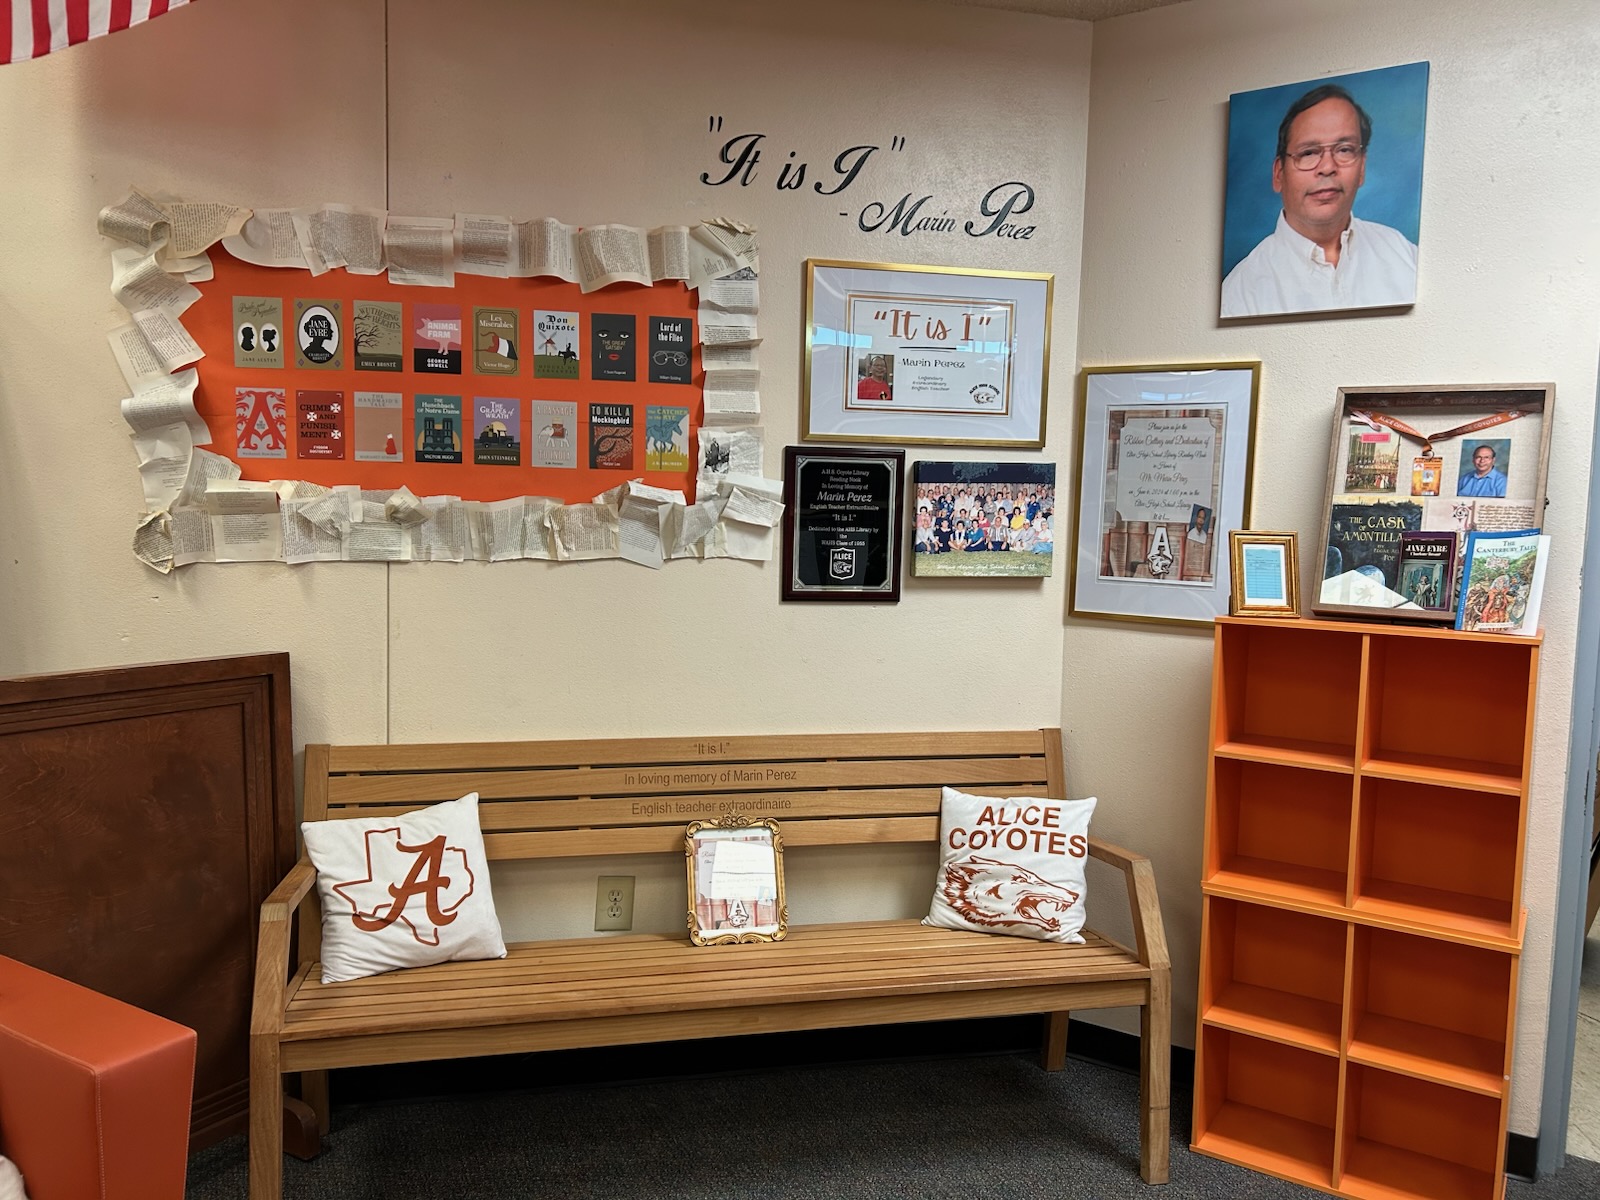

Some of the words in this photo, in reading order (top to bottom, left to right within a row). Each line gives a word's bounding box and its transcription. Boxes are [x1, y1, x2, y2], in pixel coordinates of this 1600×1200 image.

[776, 151, 807, 190] is
[858, 193, 957, 237] Marin
[965, 182, 1036, 240] Perez
[359, 307, 399, 321] WUTHERING
[546, 314, 568, 323] Don
[308, 320, 328, 329] JANE
[372, 315, 401, 329] HEIGHTS
[427, 322, 459, 331] ANIMAL
[538, 322, 575, 332] Quixote
[660, 322, 674, 332] Lord
[675, 323, 682, 332] of
[308, 328, 328, 337] EYRE
[926, 317, 952, 340] is
[427, 330, 451, 338] FARM
[658, 332, 668, 341] the
[669, 333, 683, 342] Flies
[902, 358, 930, 367] Marin
[934, 359, 966, 368] Perez
[480, 406, 506, 414] GRAPES
[508, 408, 514, 416] of
[544, 406, 574, 416] PASSAGE
[592, 406, 600, 414] TO
[604, 406, 622, 416] KILL
[625, 407, 630, 416] A
[592, 416, 630, 425] Mockingbird
[1379, 416, 1393, 424] ALICE
[1473, 416, 1502, 428] COYOTES
[817, 491, 846, 501] Marin
[847, 492, 872, 502] Perez
[1368, 516, 1406, 529] CASK
[1342, 531, 1402, 542] AMONTILLA
[707, 744, 716, 754] is
[624, 774, 634, 785] In
[638, 773, 670, 786] loving
[673, 772, 717, 786] memory
[720, 770, 731, 782] of
[734, 770, 762, 782] Marin
[766, 769, 796, 781] Perez
[632, 802, 672, 817] English
[675, 801, 716, 812] teacher
[719, 799, 792, 812] extraordinaire
[976, 805, 1061, 828] ALICE
[949, 828, 1087, 858] COYOTES
[352, 835, 458, 932] A
